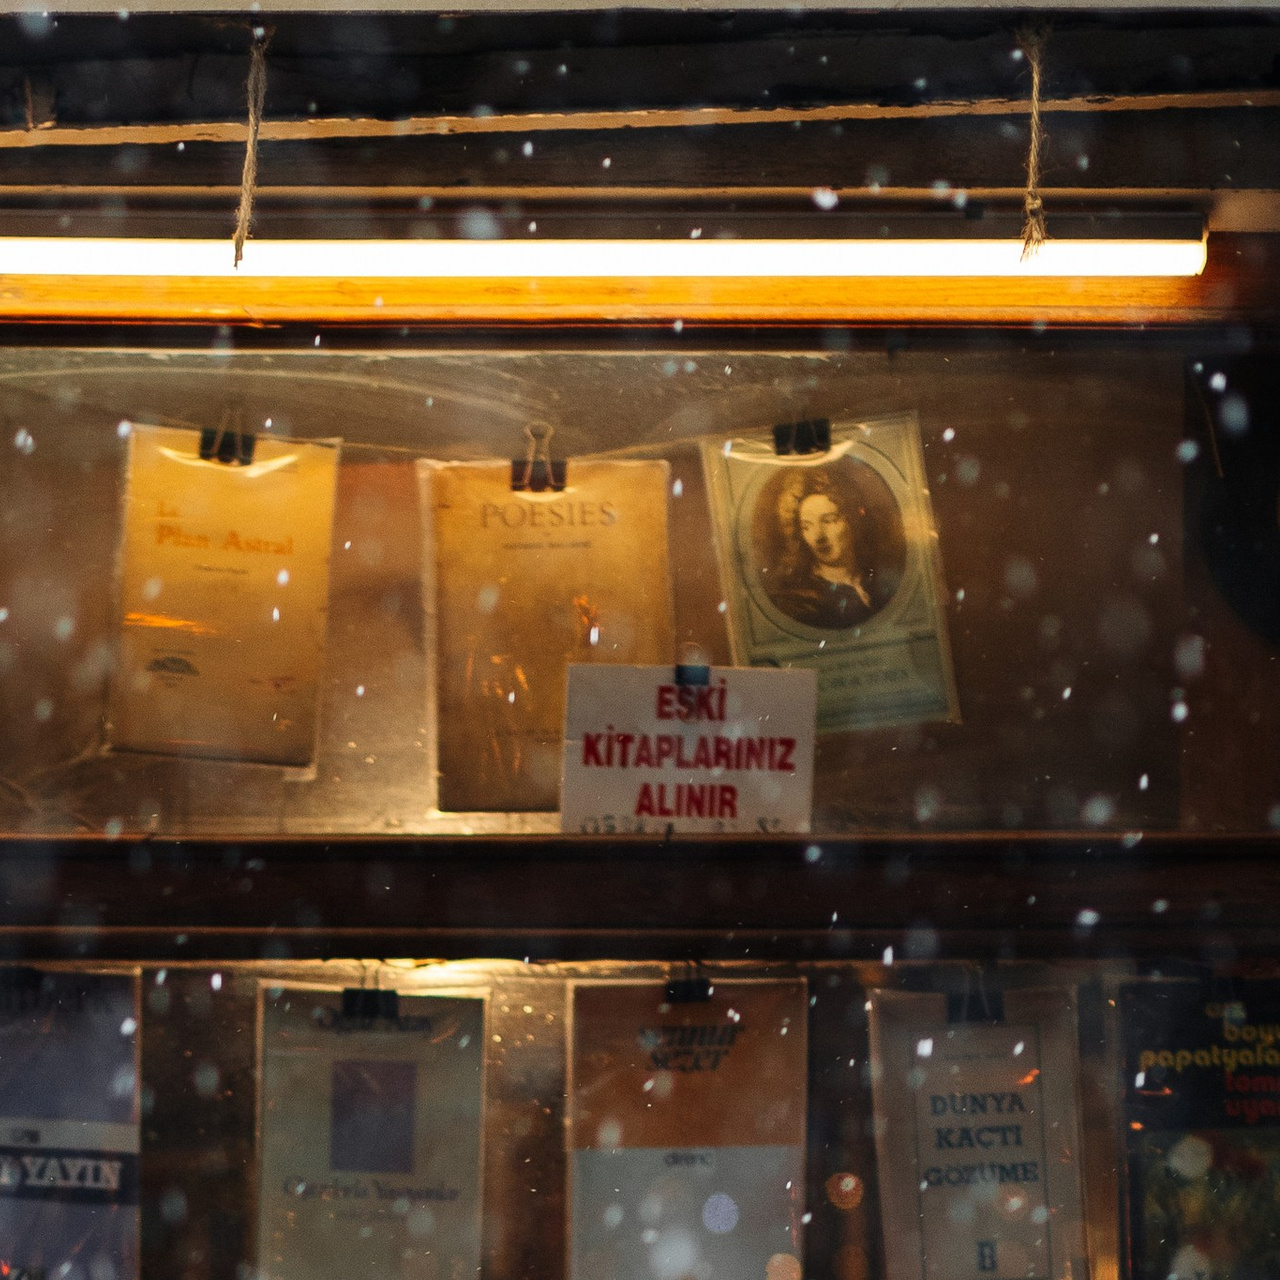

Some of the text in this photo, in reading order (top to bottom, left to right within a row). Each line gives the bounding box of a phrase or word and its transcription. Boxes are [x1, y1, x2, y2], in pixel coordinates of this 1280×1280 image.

[655, 677, 728, 722] ESKİ
[581, 723, 797, 772] KİTAPLARINIZ
[634, 781, 739, 819] ALINIR
[21, 1155, 123, 1190] YAYIN
